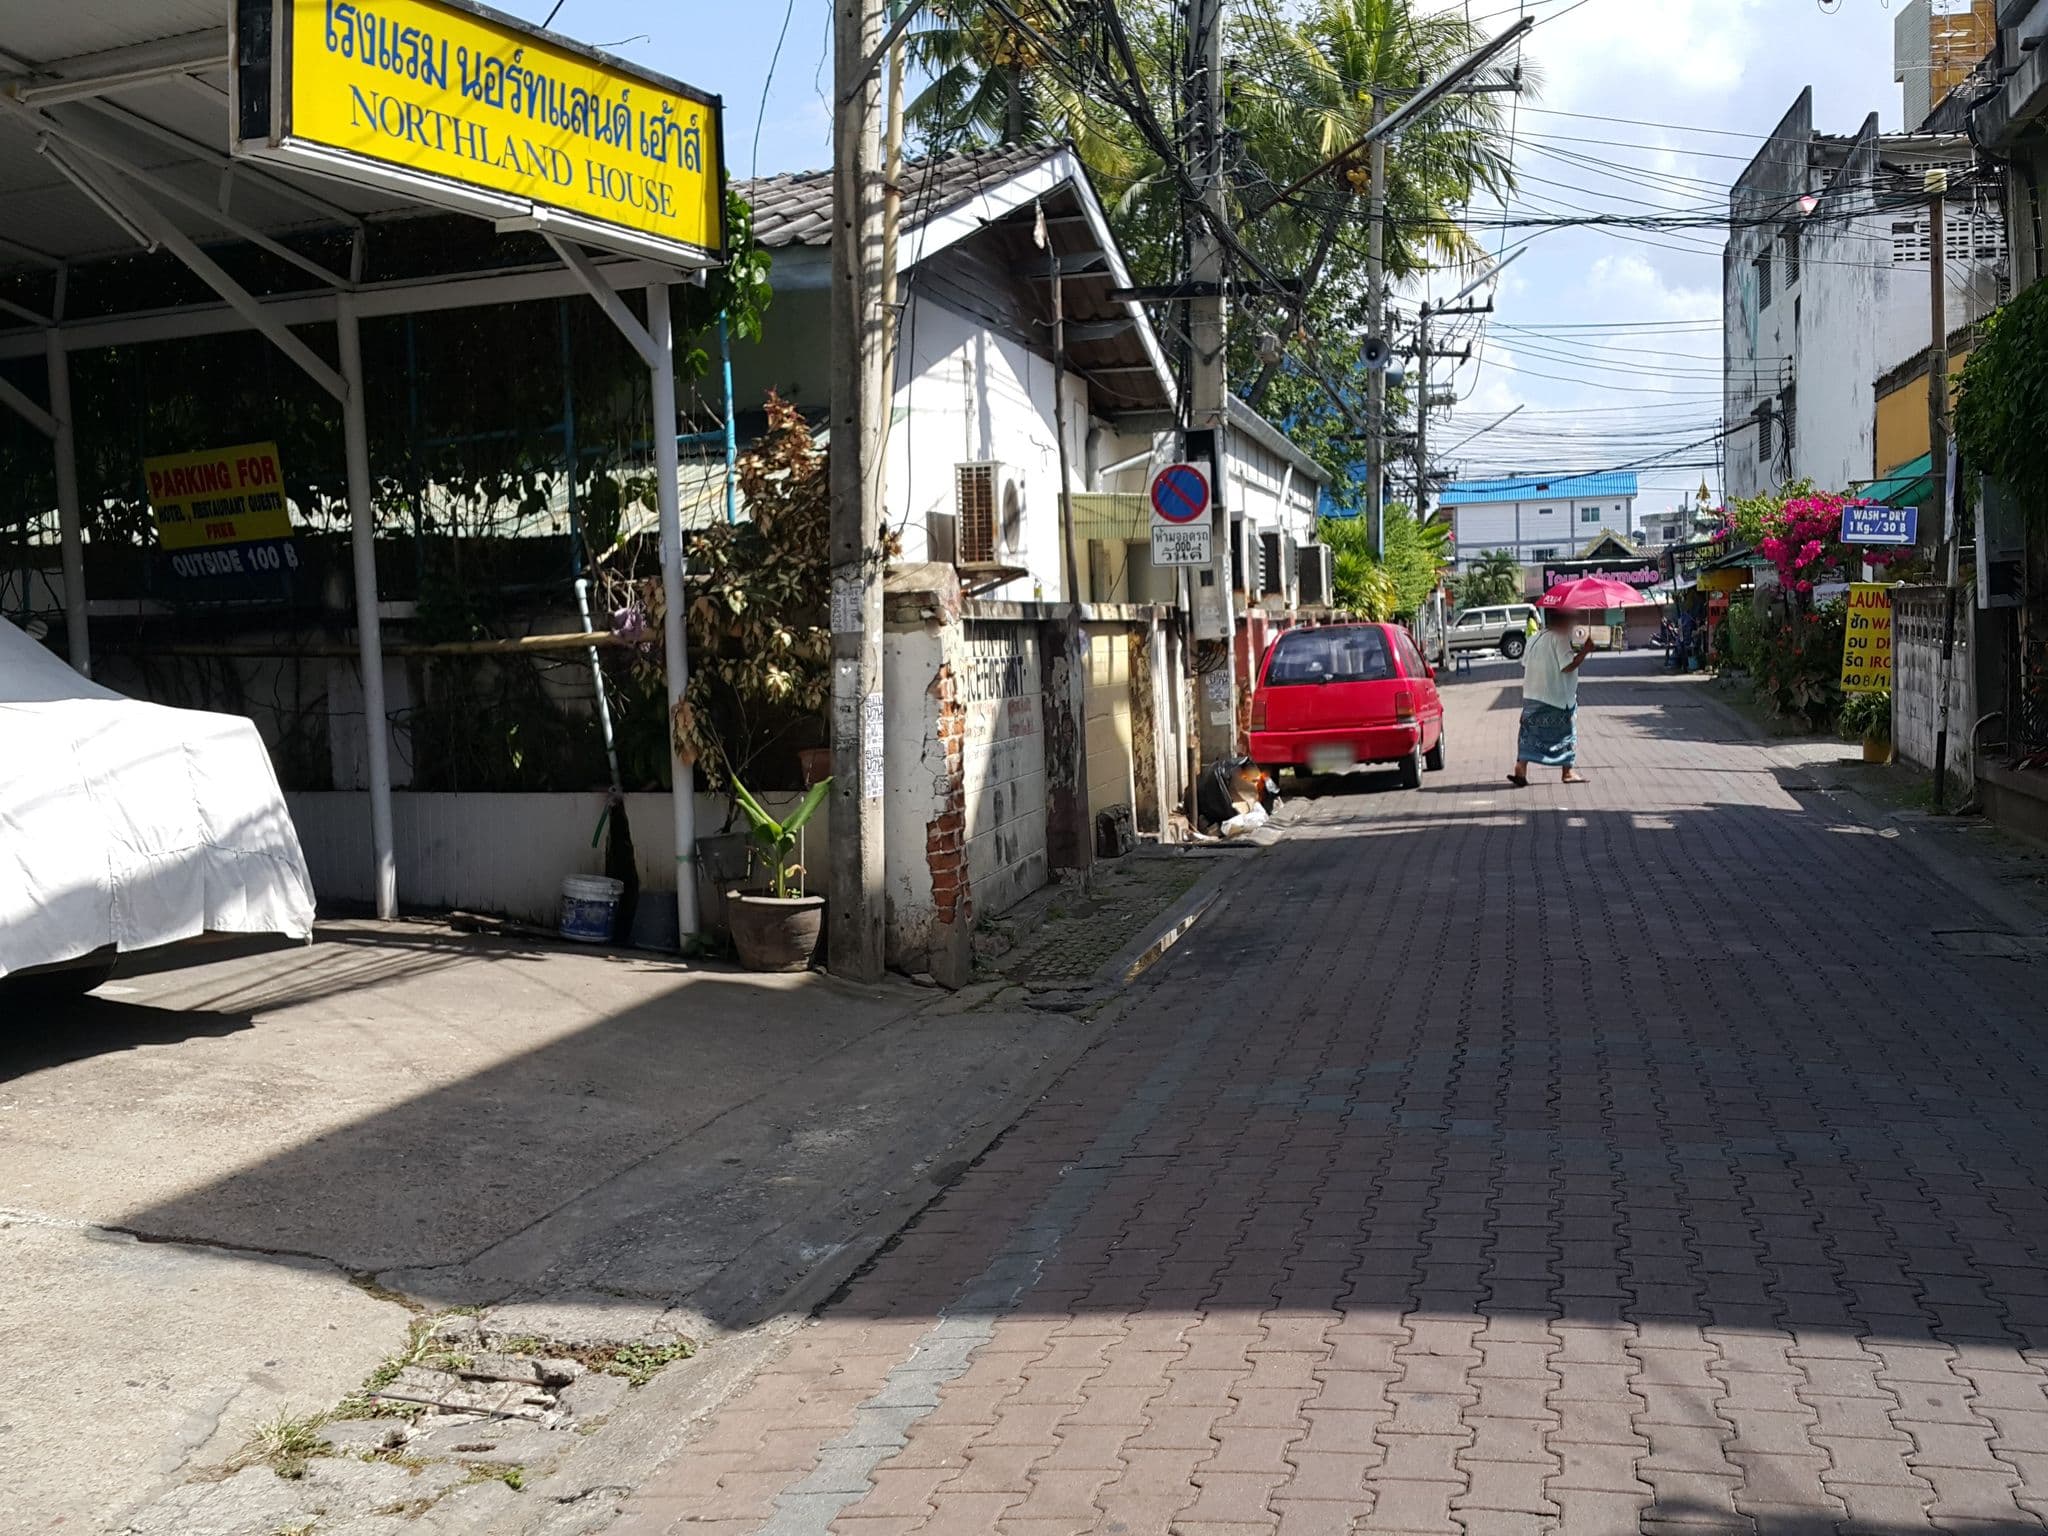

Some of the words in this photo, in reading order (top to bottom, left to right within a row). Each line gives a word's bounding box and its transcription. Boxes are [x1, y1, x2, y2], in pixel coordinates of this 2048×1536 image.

[326, 0, 447, 90] โรงแรม
[457, 48, 632, 151] นอร์ทแลนด์
[639, 100, 701, 173] เฮ้าส์
[349, 84, 573, 186] NORTHLAND
[584, 158, 677, 218] HOUSE
[150, 461, 232, 498] PARKING
[236, 455, 277, 487] FOR
[1853, 510, 1879, 520] WASH
[1889, 510, 1907, 521] DRY
[1155, 528, 1208, 542] ห้ามจอดรถ
[172, 549, 244, 577] OUTSIDE
[248, 545, 280, 570] 100
[1848, 637, 1867, 648] อบ
[1845, 652, 1863, 667] รีด
